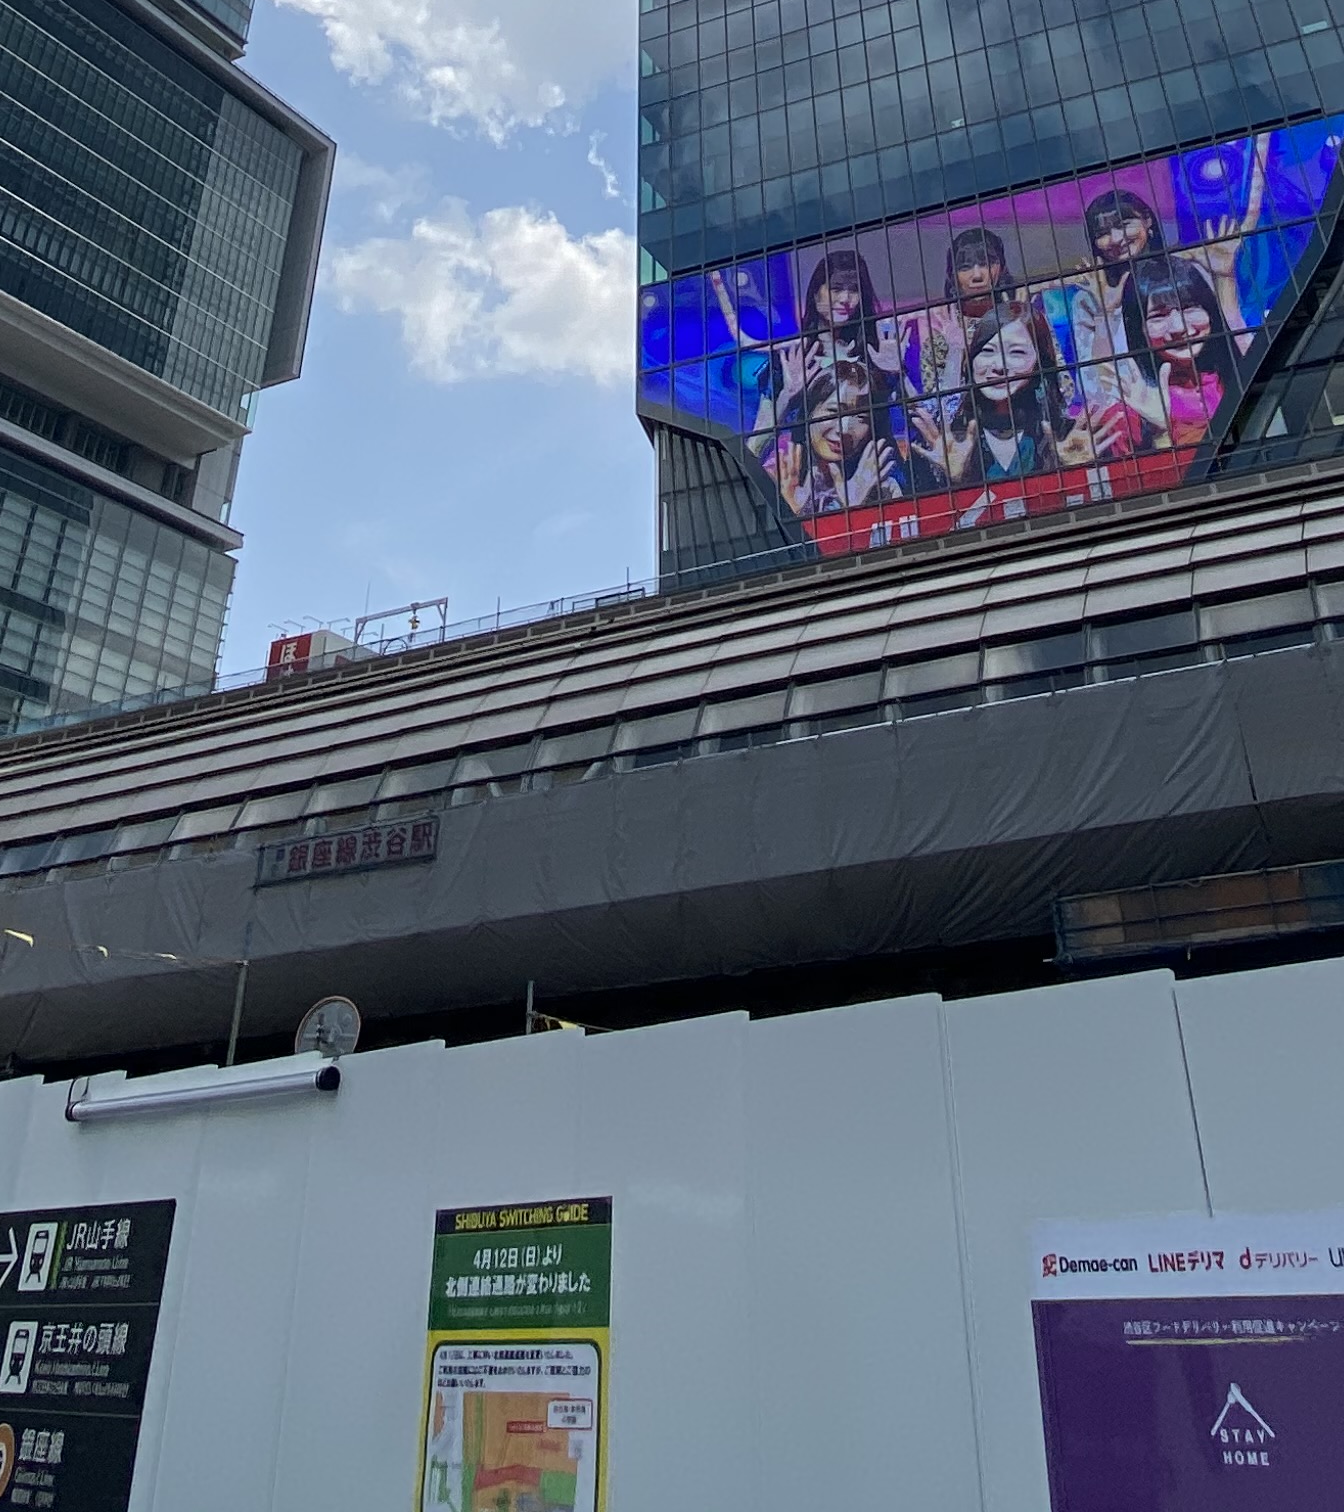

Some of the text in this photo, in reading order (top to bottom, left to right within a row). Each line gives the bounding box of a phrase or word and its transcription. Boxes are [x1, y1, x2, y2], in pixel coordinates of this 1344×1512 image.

[455, 1211, 496, 1229] SHIBUYA
[499, 1208, 553, 1228] SWITCHING
[66, 1218, 131, 1250] JR山手線
[1059, 1255, 1138, 1274] Demae-can
[39, 1321, 130, 1356] 京王井の頭線
[1220, 1429, 1265, 1444] STAY
[1223, 1450, 1270, 1466] HOME
